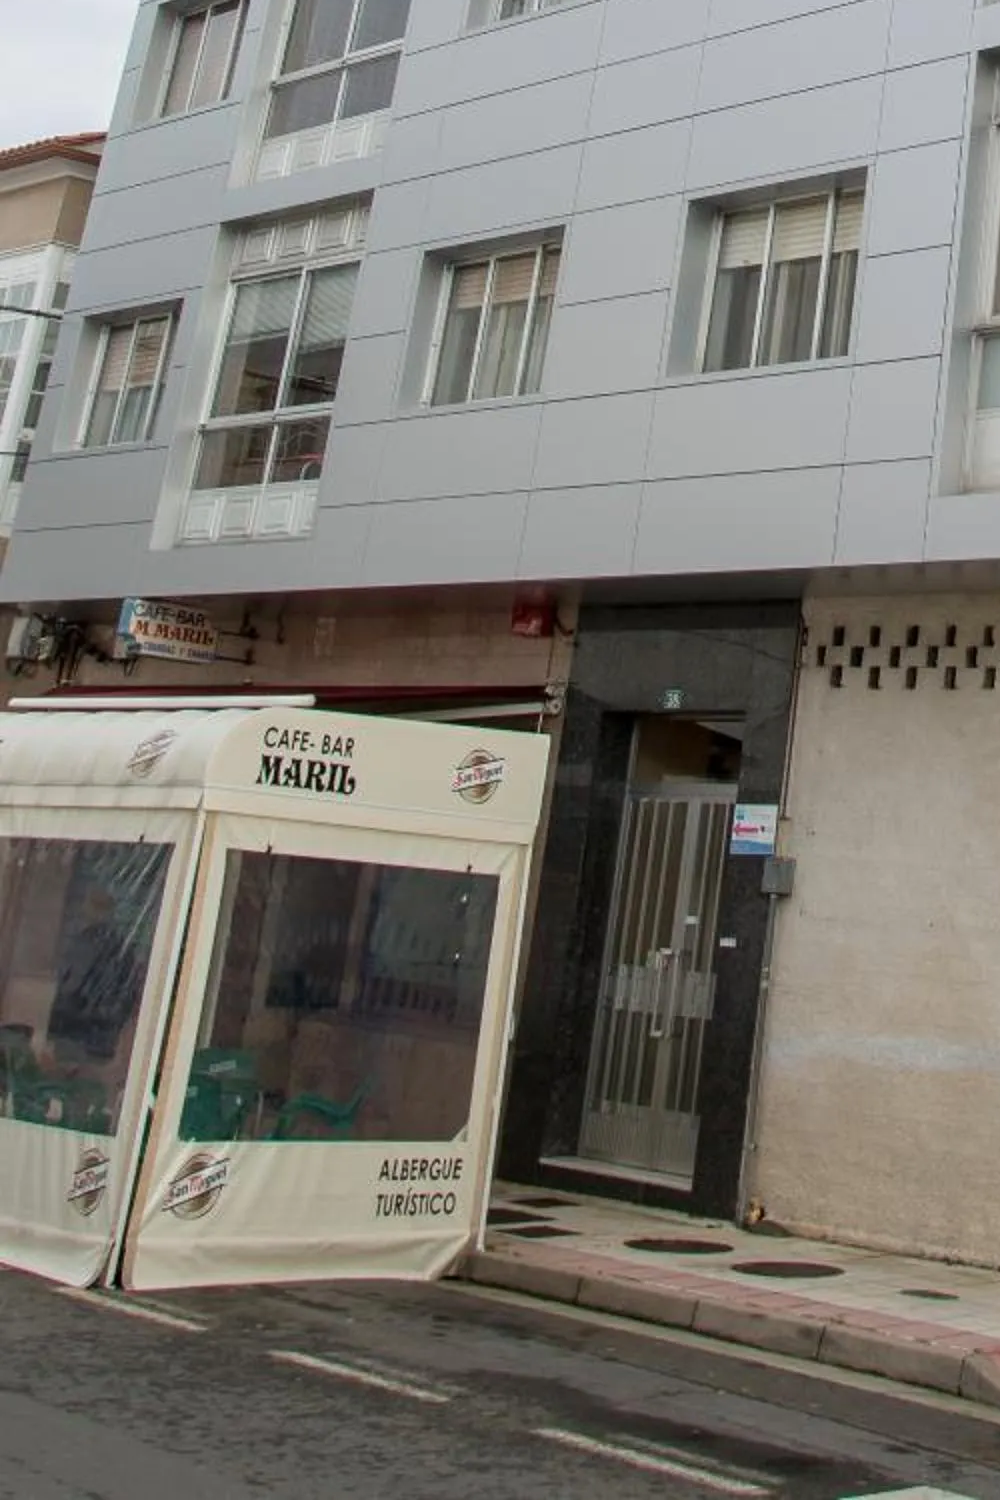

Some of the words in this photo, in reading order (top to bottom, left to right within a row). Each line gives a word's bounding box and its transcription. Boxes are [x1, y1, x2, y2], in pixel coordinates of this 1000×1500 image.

[321, 733, 356, 758] BAR
[255, 753, 357, 795] MARIL
[378, 1158, 463, 1181] ALBERGUE
[376, 1187, 457, 1217] TURÍSTICO
